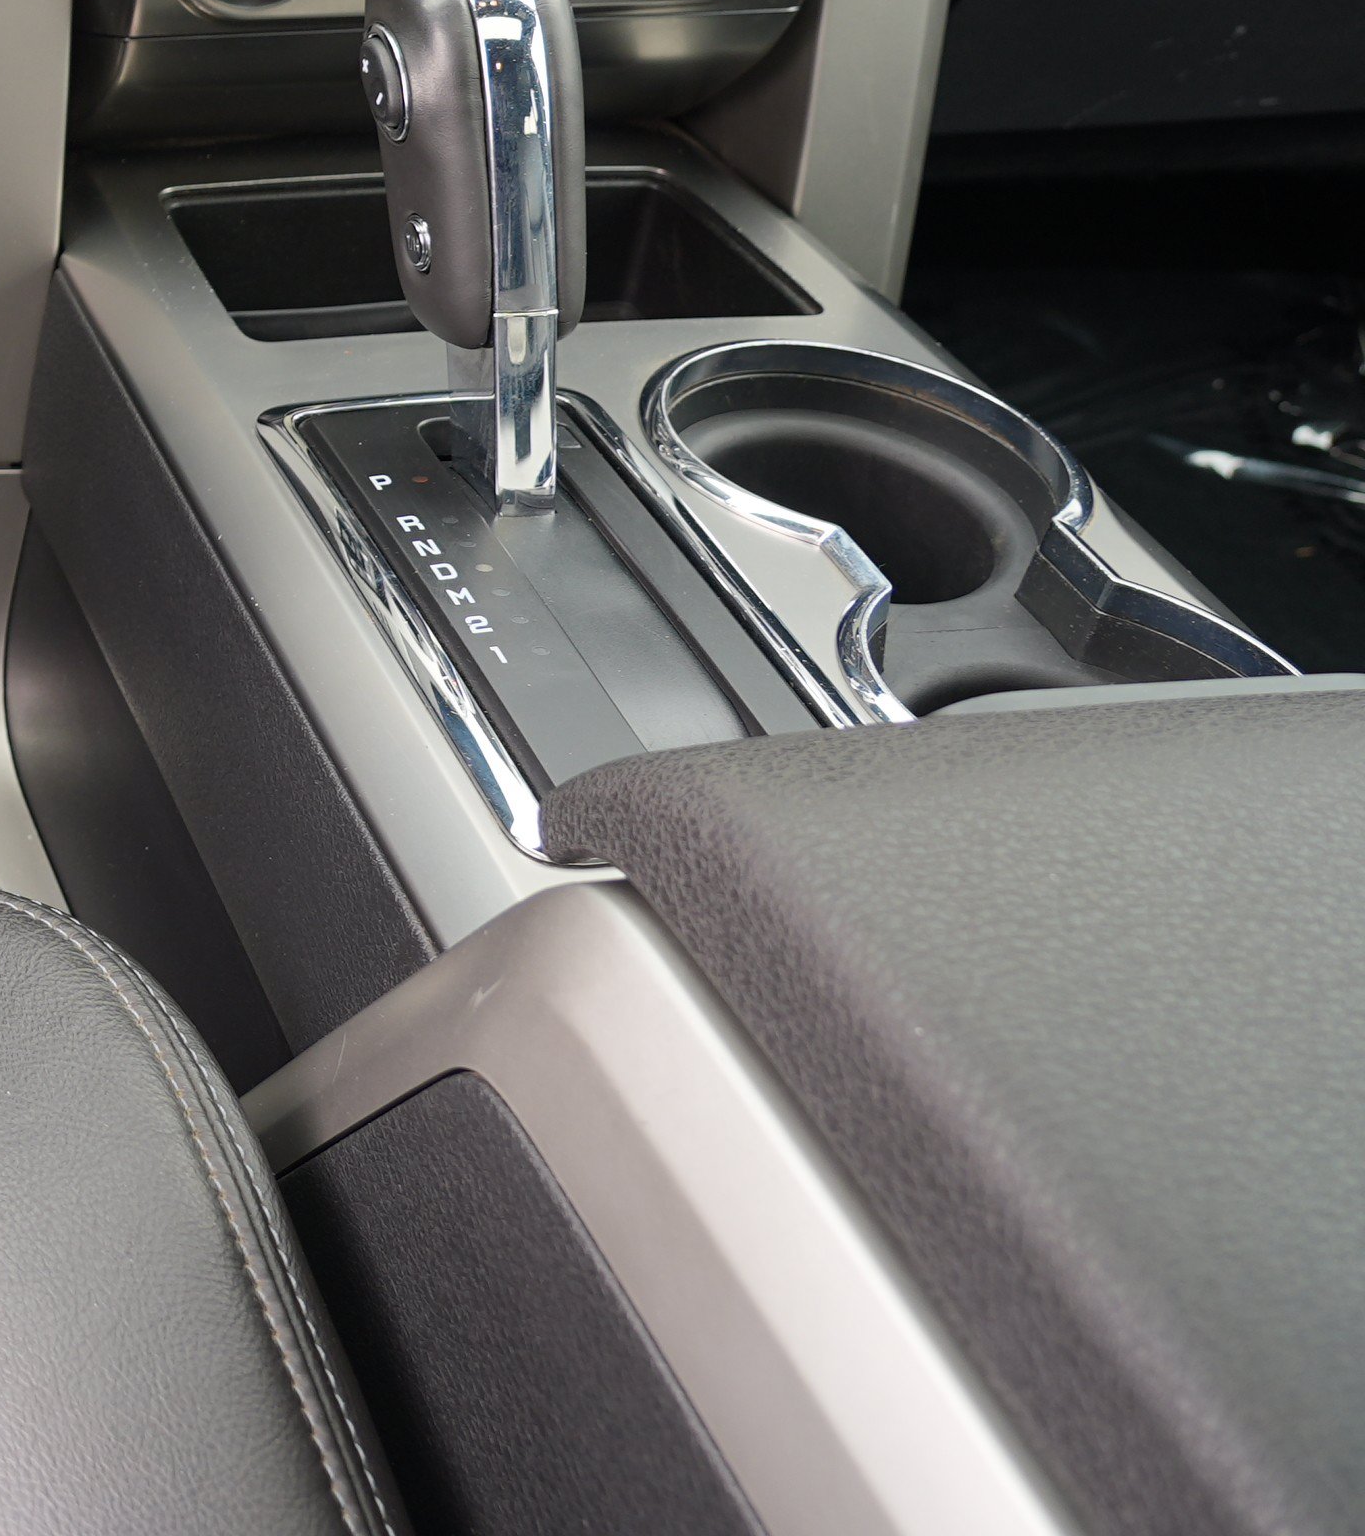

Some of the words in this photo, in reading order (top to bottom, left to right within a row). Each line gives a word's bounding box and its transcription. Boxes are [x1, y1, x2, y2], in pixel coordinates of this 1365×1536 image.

[368, 474, 392, 491] P
[396, 515, 425, 533] R
[412, 539, 442, 556] N
[429, 563, 458, 580] D
[445, 587, 476, 605] M
[464, 615, 494, 634] 2
